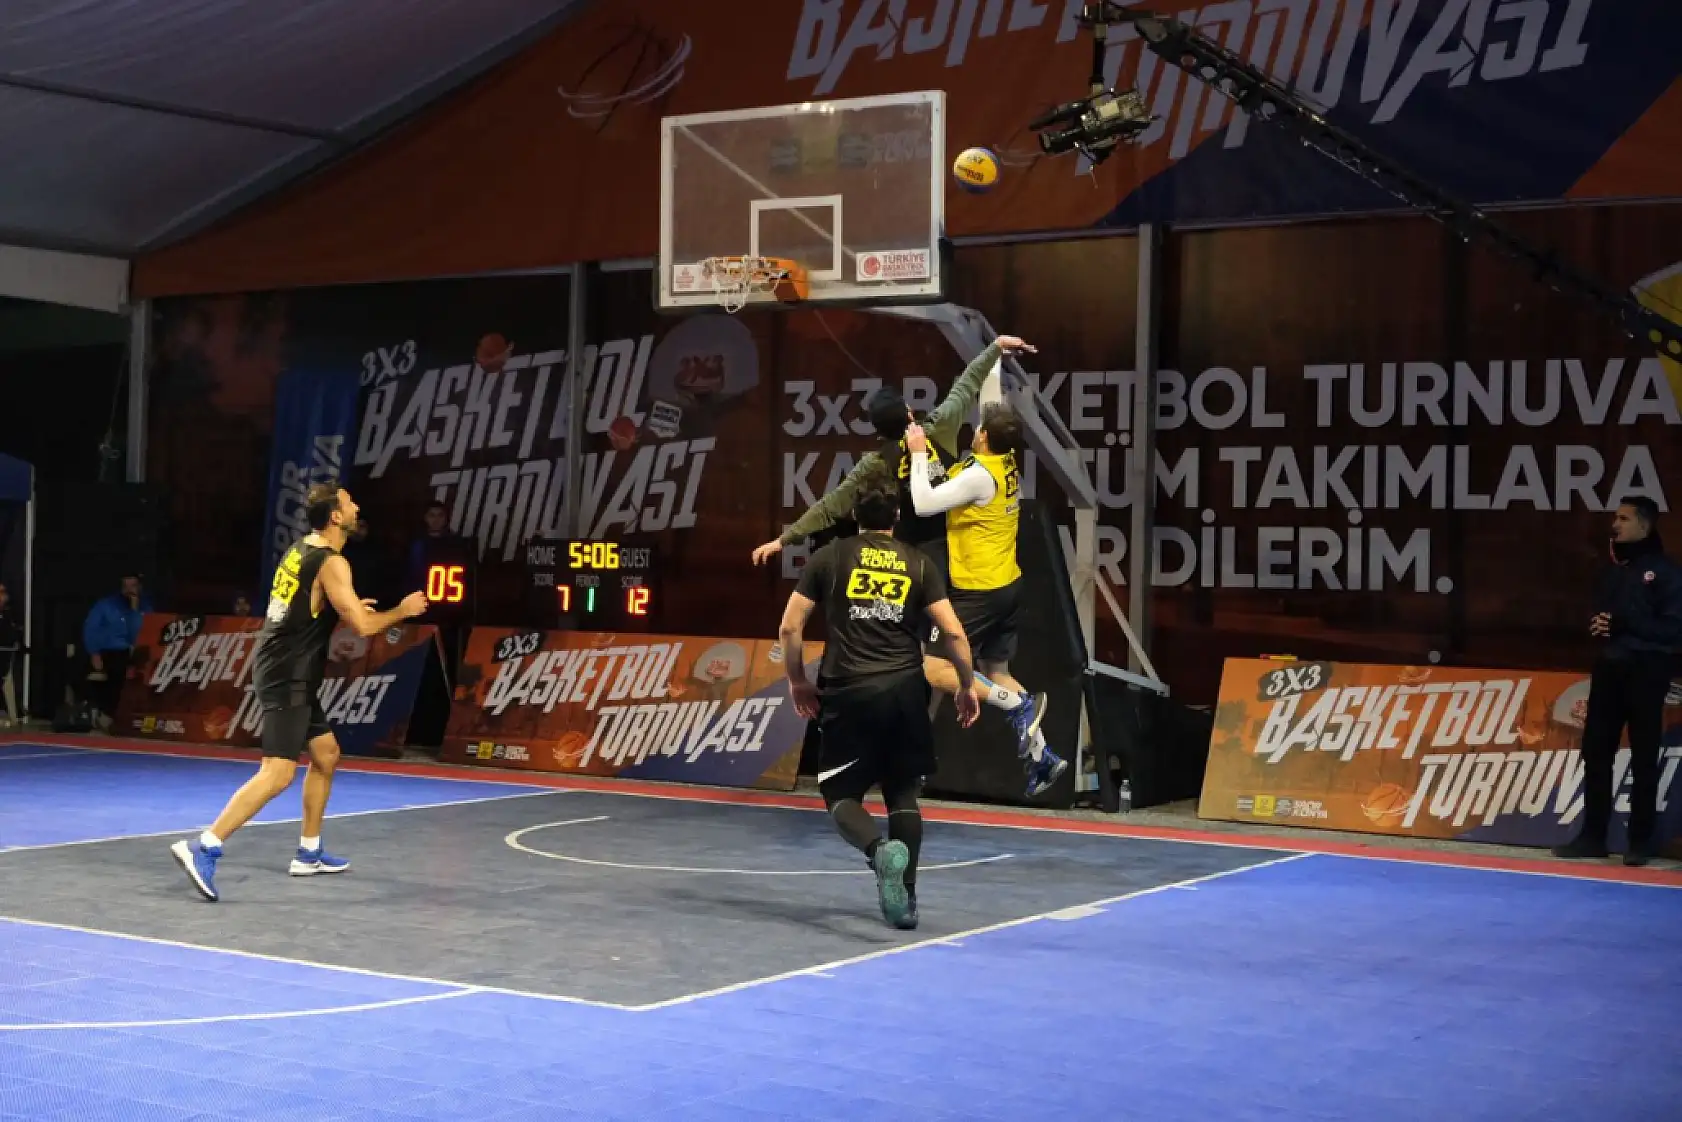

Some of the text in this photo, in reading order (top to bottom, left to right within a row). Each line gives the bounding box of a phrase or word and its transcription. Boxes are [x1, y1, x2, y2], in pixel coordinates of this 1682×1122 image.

[360, 340, 417, 388] 3X3
[1219, 444, 1670, 513] TAKIMLARA
[527, 542, 651, 569] HOME 5:06 GUEST
[1151, 508, 1455, 595] DİLERİM.
[427, 565, 464, 603] 05
[557, 585, 650, 616] 7 1 12
[853, 573, 906, 600] 3x3
[498, 632, 539, 659] 3X3
[483, 642, 683, 716] BASKETBOL
[1265, 665, 1322, 697] 3X3
[578, 697, 784, 768] TURNUVASI
[1254, 678, 1532, 765] BASKETBOL
